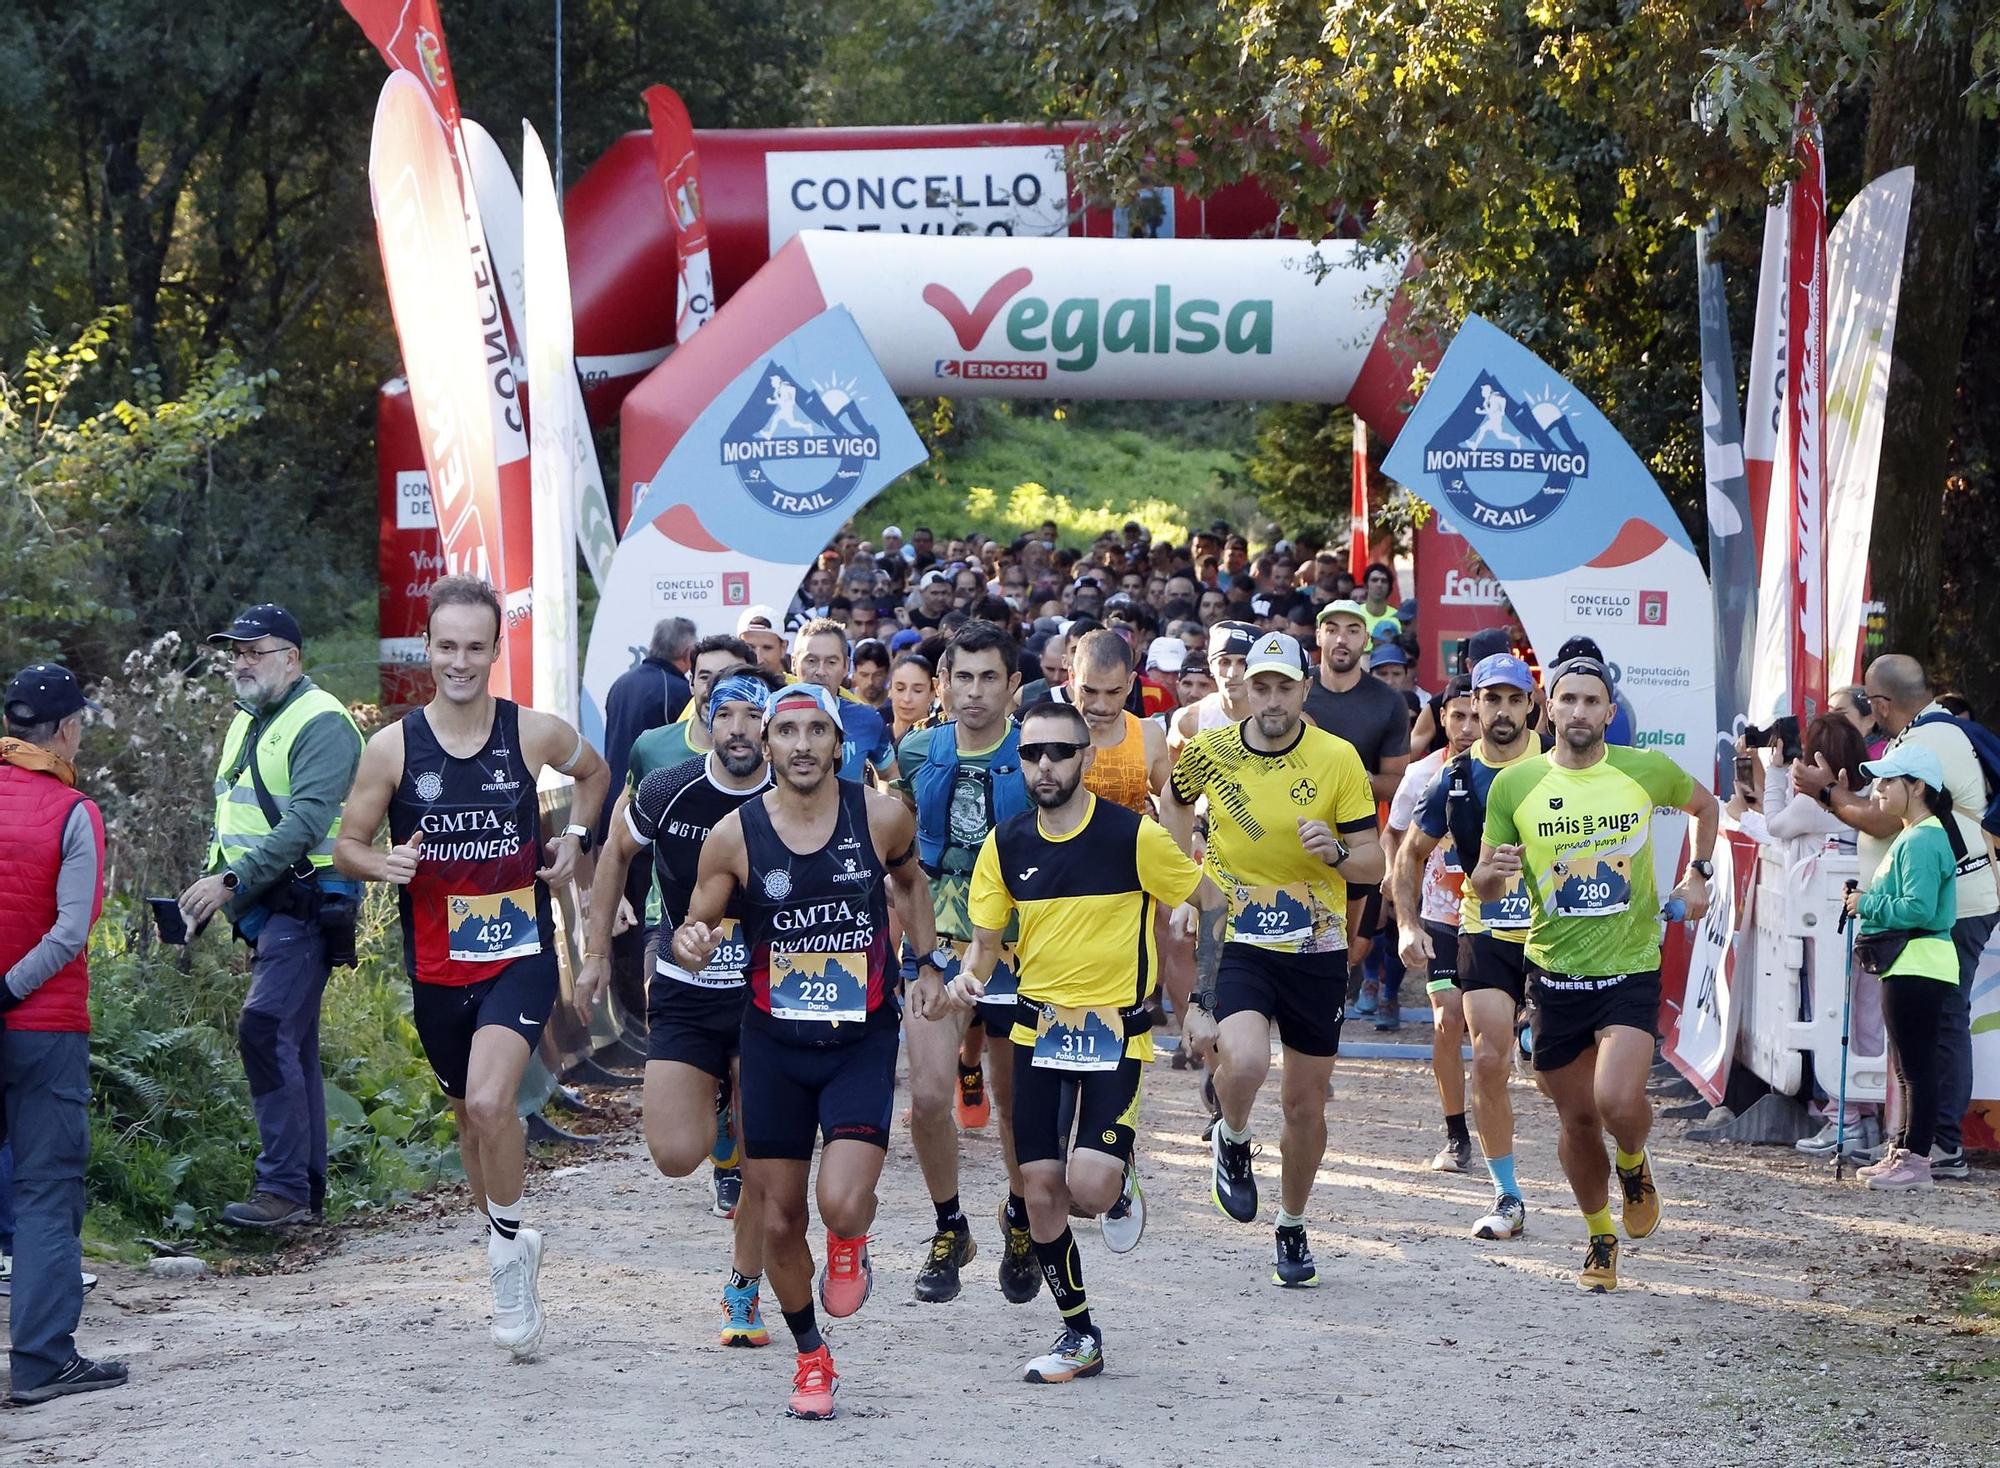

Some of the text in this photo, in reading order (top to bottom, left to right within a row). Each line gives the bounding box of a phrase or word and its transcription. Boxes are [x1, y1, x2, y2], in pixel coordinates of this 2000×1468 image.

[791, 173, 1042, 211] CONCELLO
[922, 267, 1273, 373] Vegalsa
[967, 362, 1044, 378] EROSKI
[723, 437, 877, 463] MONTES DE VIGO
[1426, 450, 1586, 476] MONTES DE VIGO
[411, 501, 431, 515] DE
[770, 490, 833, 513] TRAIL
[1472, 502, 1536, 527] TRAIL
[656, 579, 714, 591] CONCELLO
[663, 590, 708, 601] DE VIGO
[1570, 595, 1631, 606] CONCELLO
[1577, 606, 1623, 617] DE VIGO
[1627, 666, 1690, 677] Deputación
[1626, 676, 1690, 687] Pontevedra
[1636, 729, 1686, 749] galsa
[481, 781, 520, 792] CHUVONERS
[420, 809, 518, 836] GMTA &
[1538, 816, 1581, 837] máis
[1597, 812, 1640, 833] auga
[418, 836, 520, 862] CHUVONERS
[1554, 838, 1591, 856] pensado
[1594, 836, 1617, 852] para
[832, 869, 873, 883] CHUVONERS
[1577, 882, 1611, 901] 280
[1500, 897, 1530, 913] 279
[1587, 899, 1603, 908] Dani
[772, 900, 871, 931] GMTA &
[1256, 910, 1290, 928] 292
[476, 921, 513, 944] 432
[1263, 927, 1285, 935] Casais
[710, 944, 746, 963] 285
[799, 981, 838, 1002] 228
[807, 1001, 829, 1011] Dario
[1061, 1034, 1095, 1054] 311
[1055, 1051, 1101, 1063] Pablo Querol
